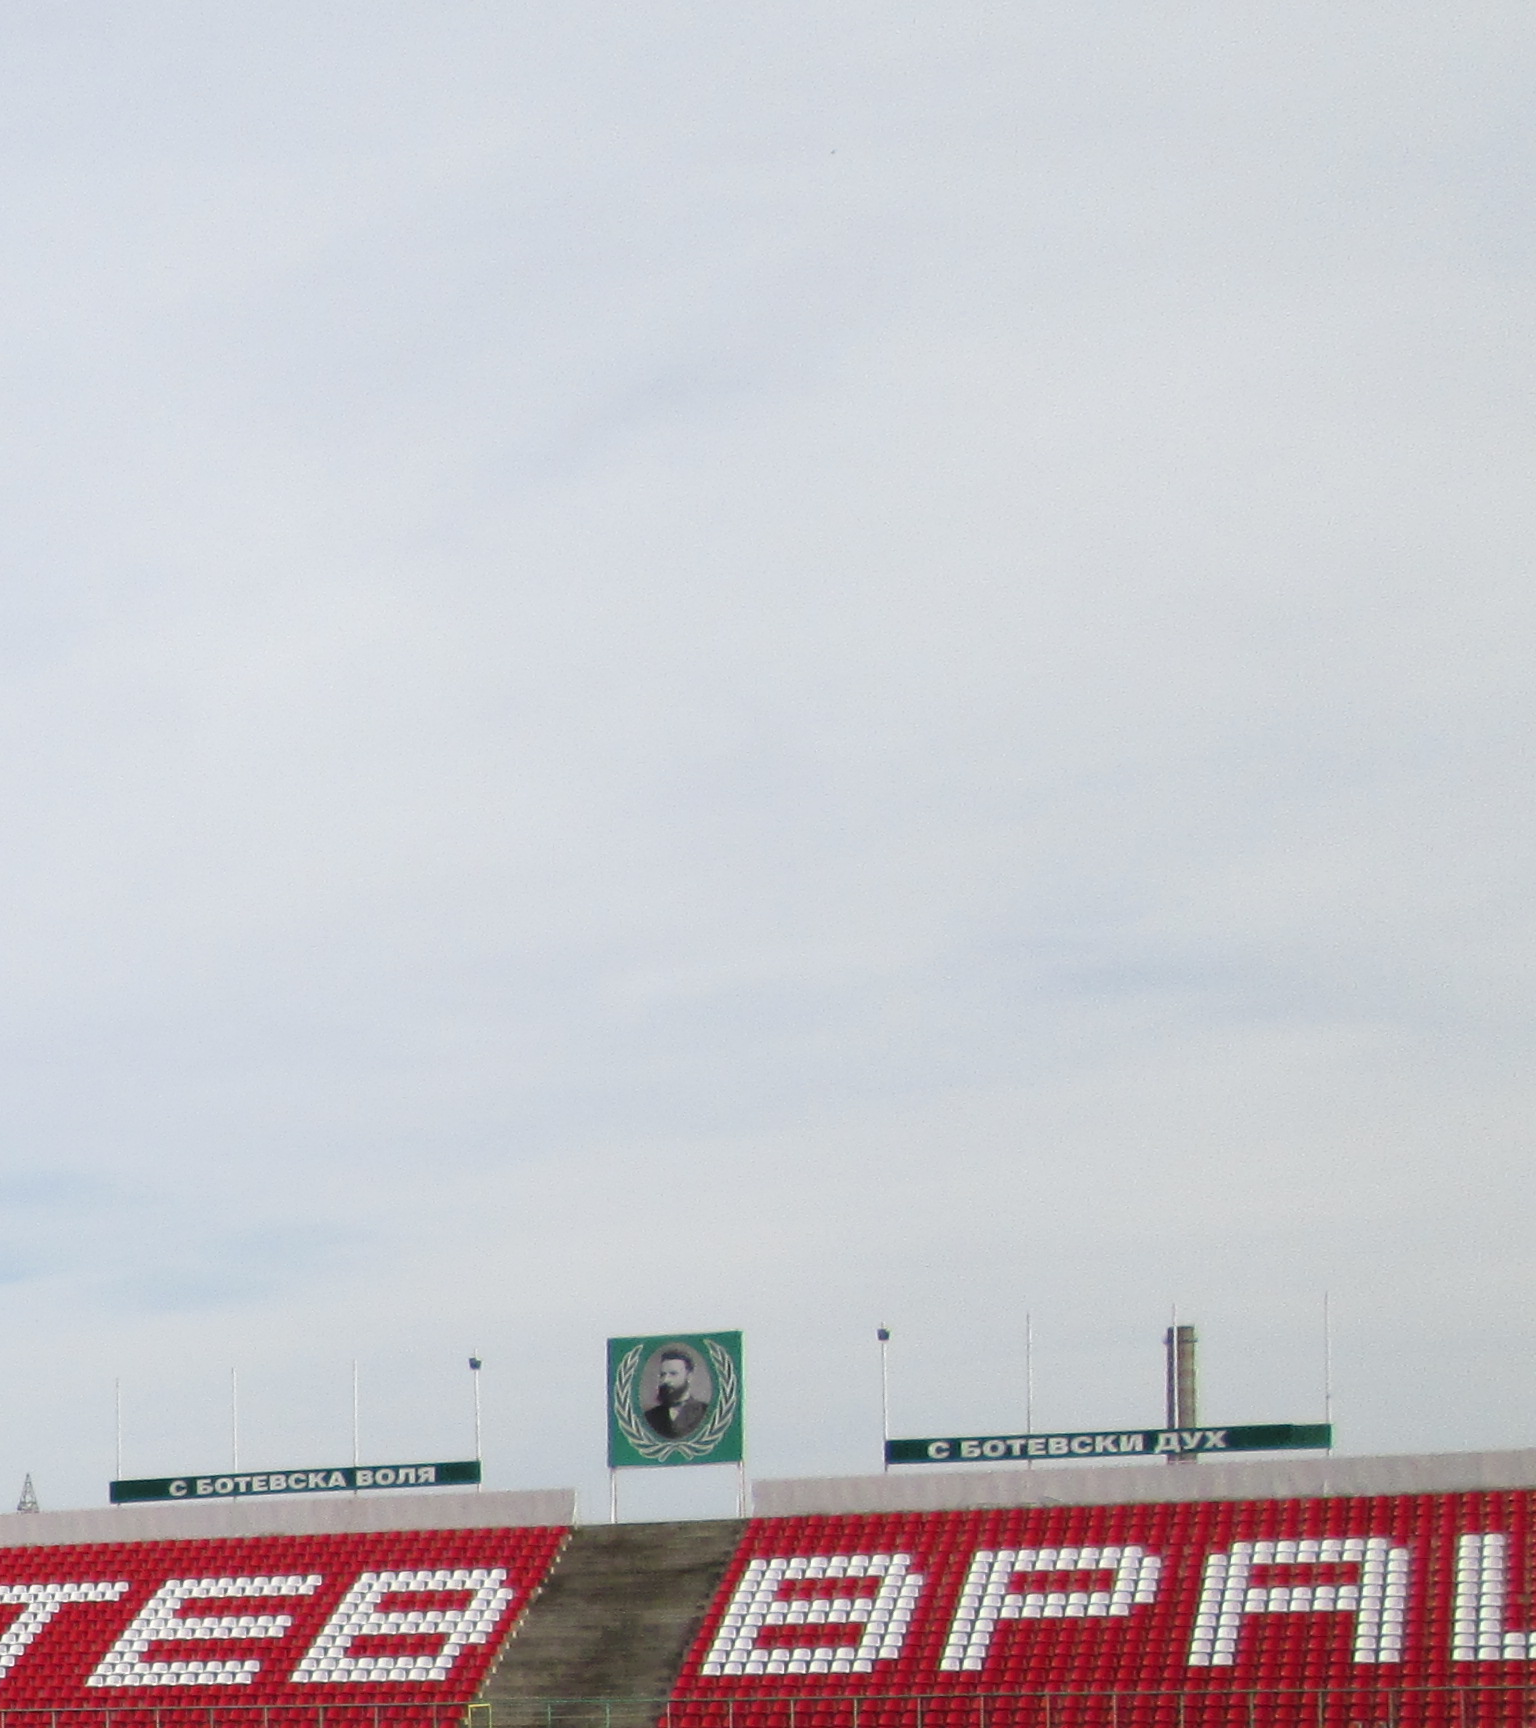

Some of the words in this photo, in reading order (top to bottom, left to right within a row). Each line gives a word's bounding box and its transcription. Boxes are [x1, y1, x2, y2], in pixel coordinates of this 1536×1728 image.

[928, 1440, 950, 1459] С
[959, 1434, 1144, 1459] БОТЕВСКИ
[1154, 1430, 1228, 1454] ДУХ
[168, 1479, 187, 1497] С
[196, 1471, 347, 1496] БОТЕВСКА
[355, 1466, 436, 1486] ВОЛЯ
